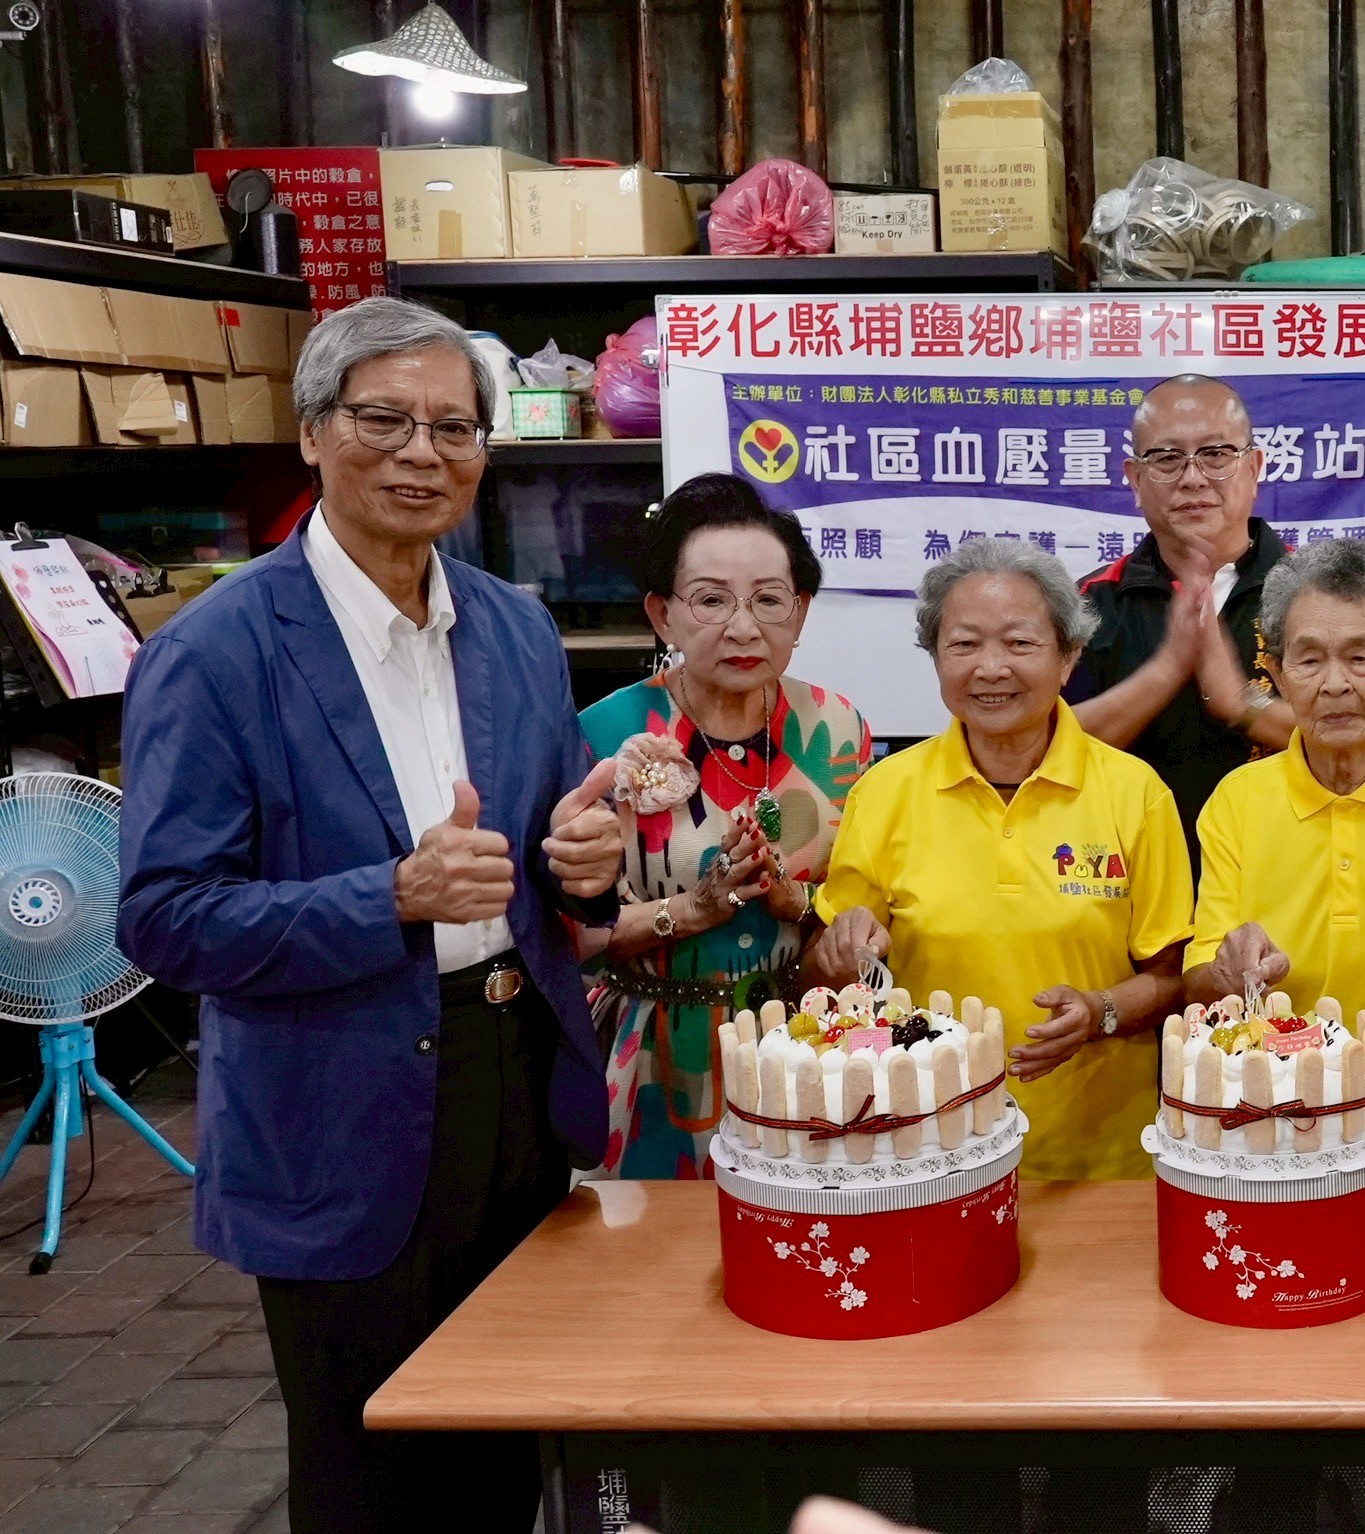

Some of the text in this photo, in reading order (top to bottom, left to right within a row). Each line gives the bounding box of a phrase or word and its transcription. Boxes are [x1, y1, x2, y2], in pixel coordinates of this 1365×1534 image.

[862, 230, 903, 239] Keep Dry
[300, 238, 382, 254] 務人家存放
[737, 1205, 794, 1228] Happy Birthday
[1272, 1292, 1304, 1302] Happy
[1306, 1286, 1346, 1300] Birthday
